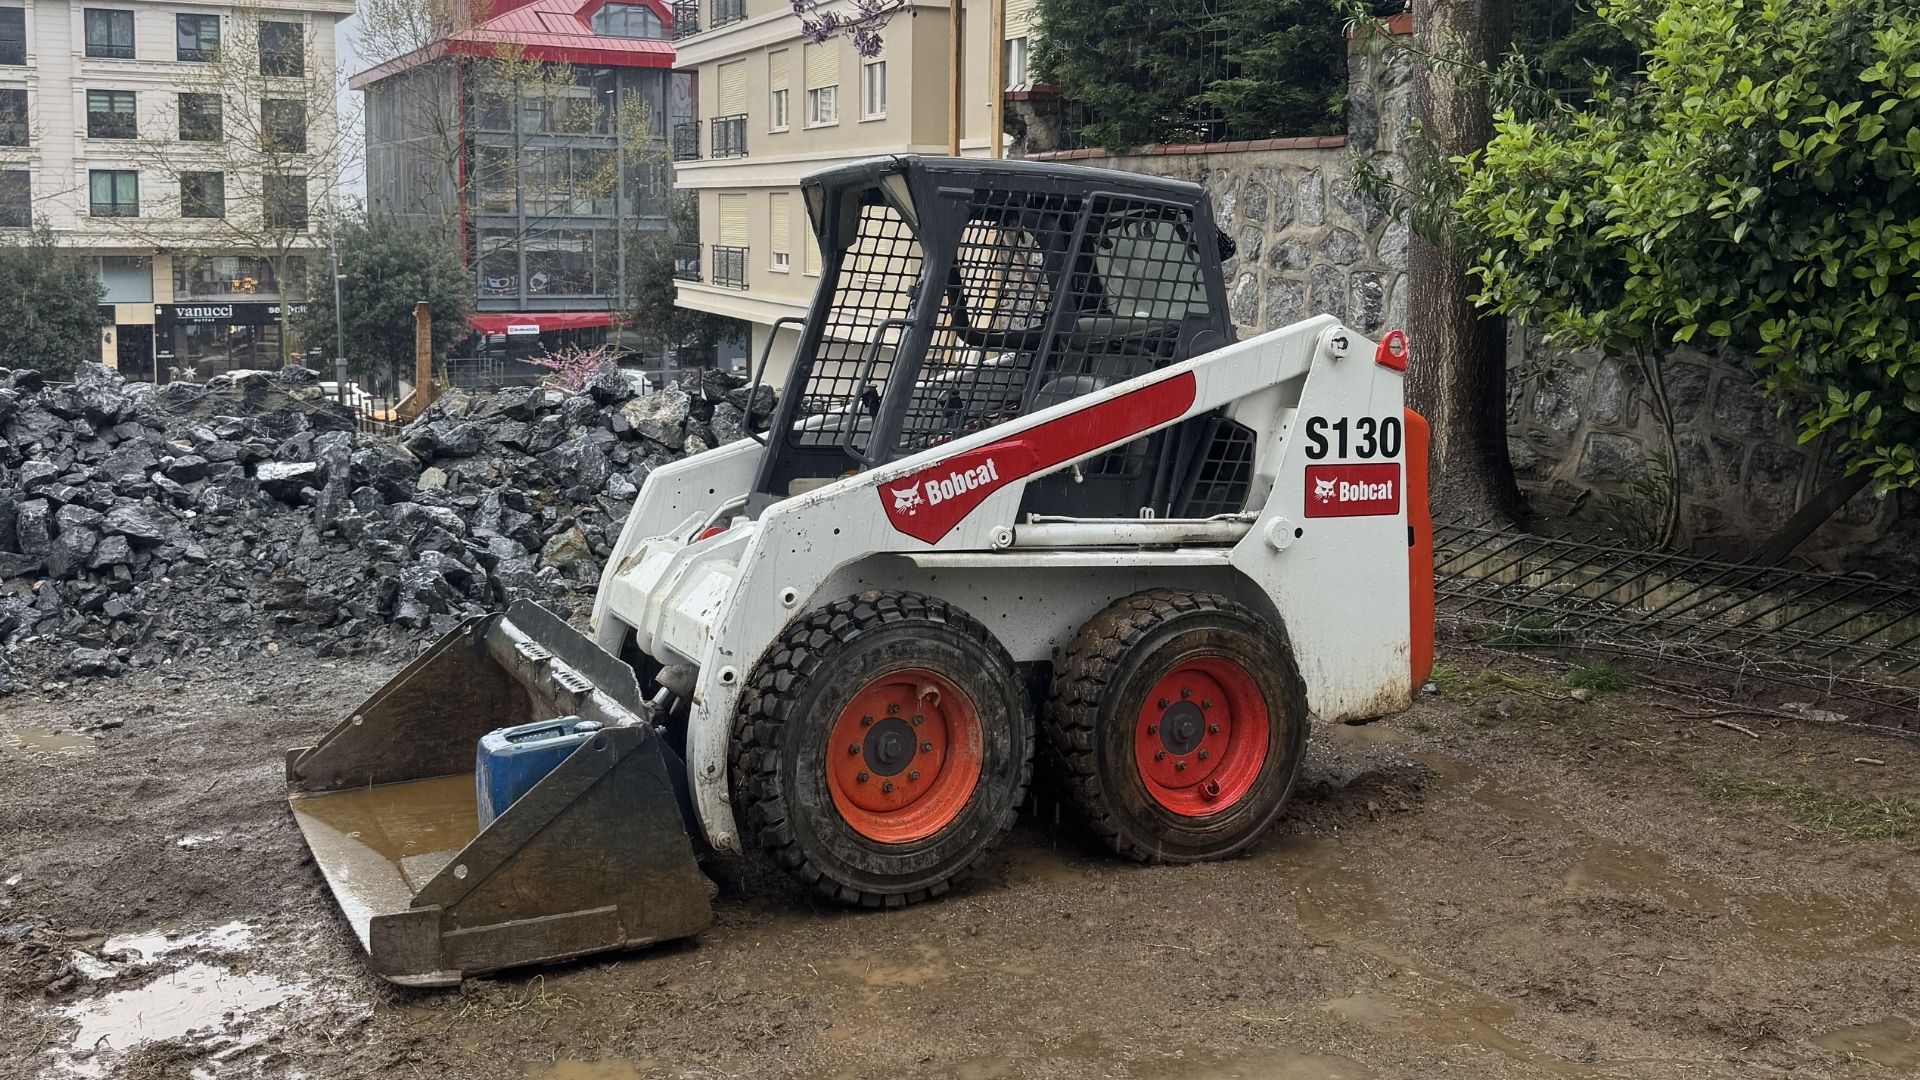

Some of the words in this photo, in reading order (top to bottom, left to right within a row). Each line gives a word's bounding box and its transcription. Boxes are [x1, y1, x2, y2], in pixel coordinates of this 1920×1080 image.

[175, 305, 233, 317] vanucci
[1305, 416, 1401, 460] S130
[924, 458, 999, 506] Bobcat
[1339, 480, 1393, 502] Bobcat
